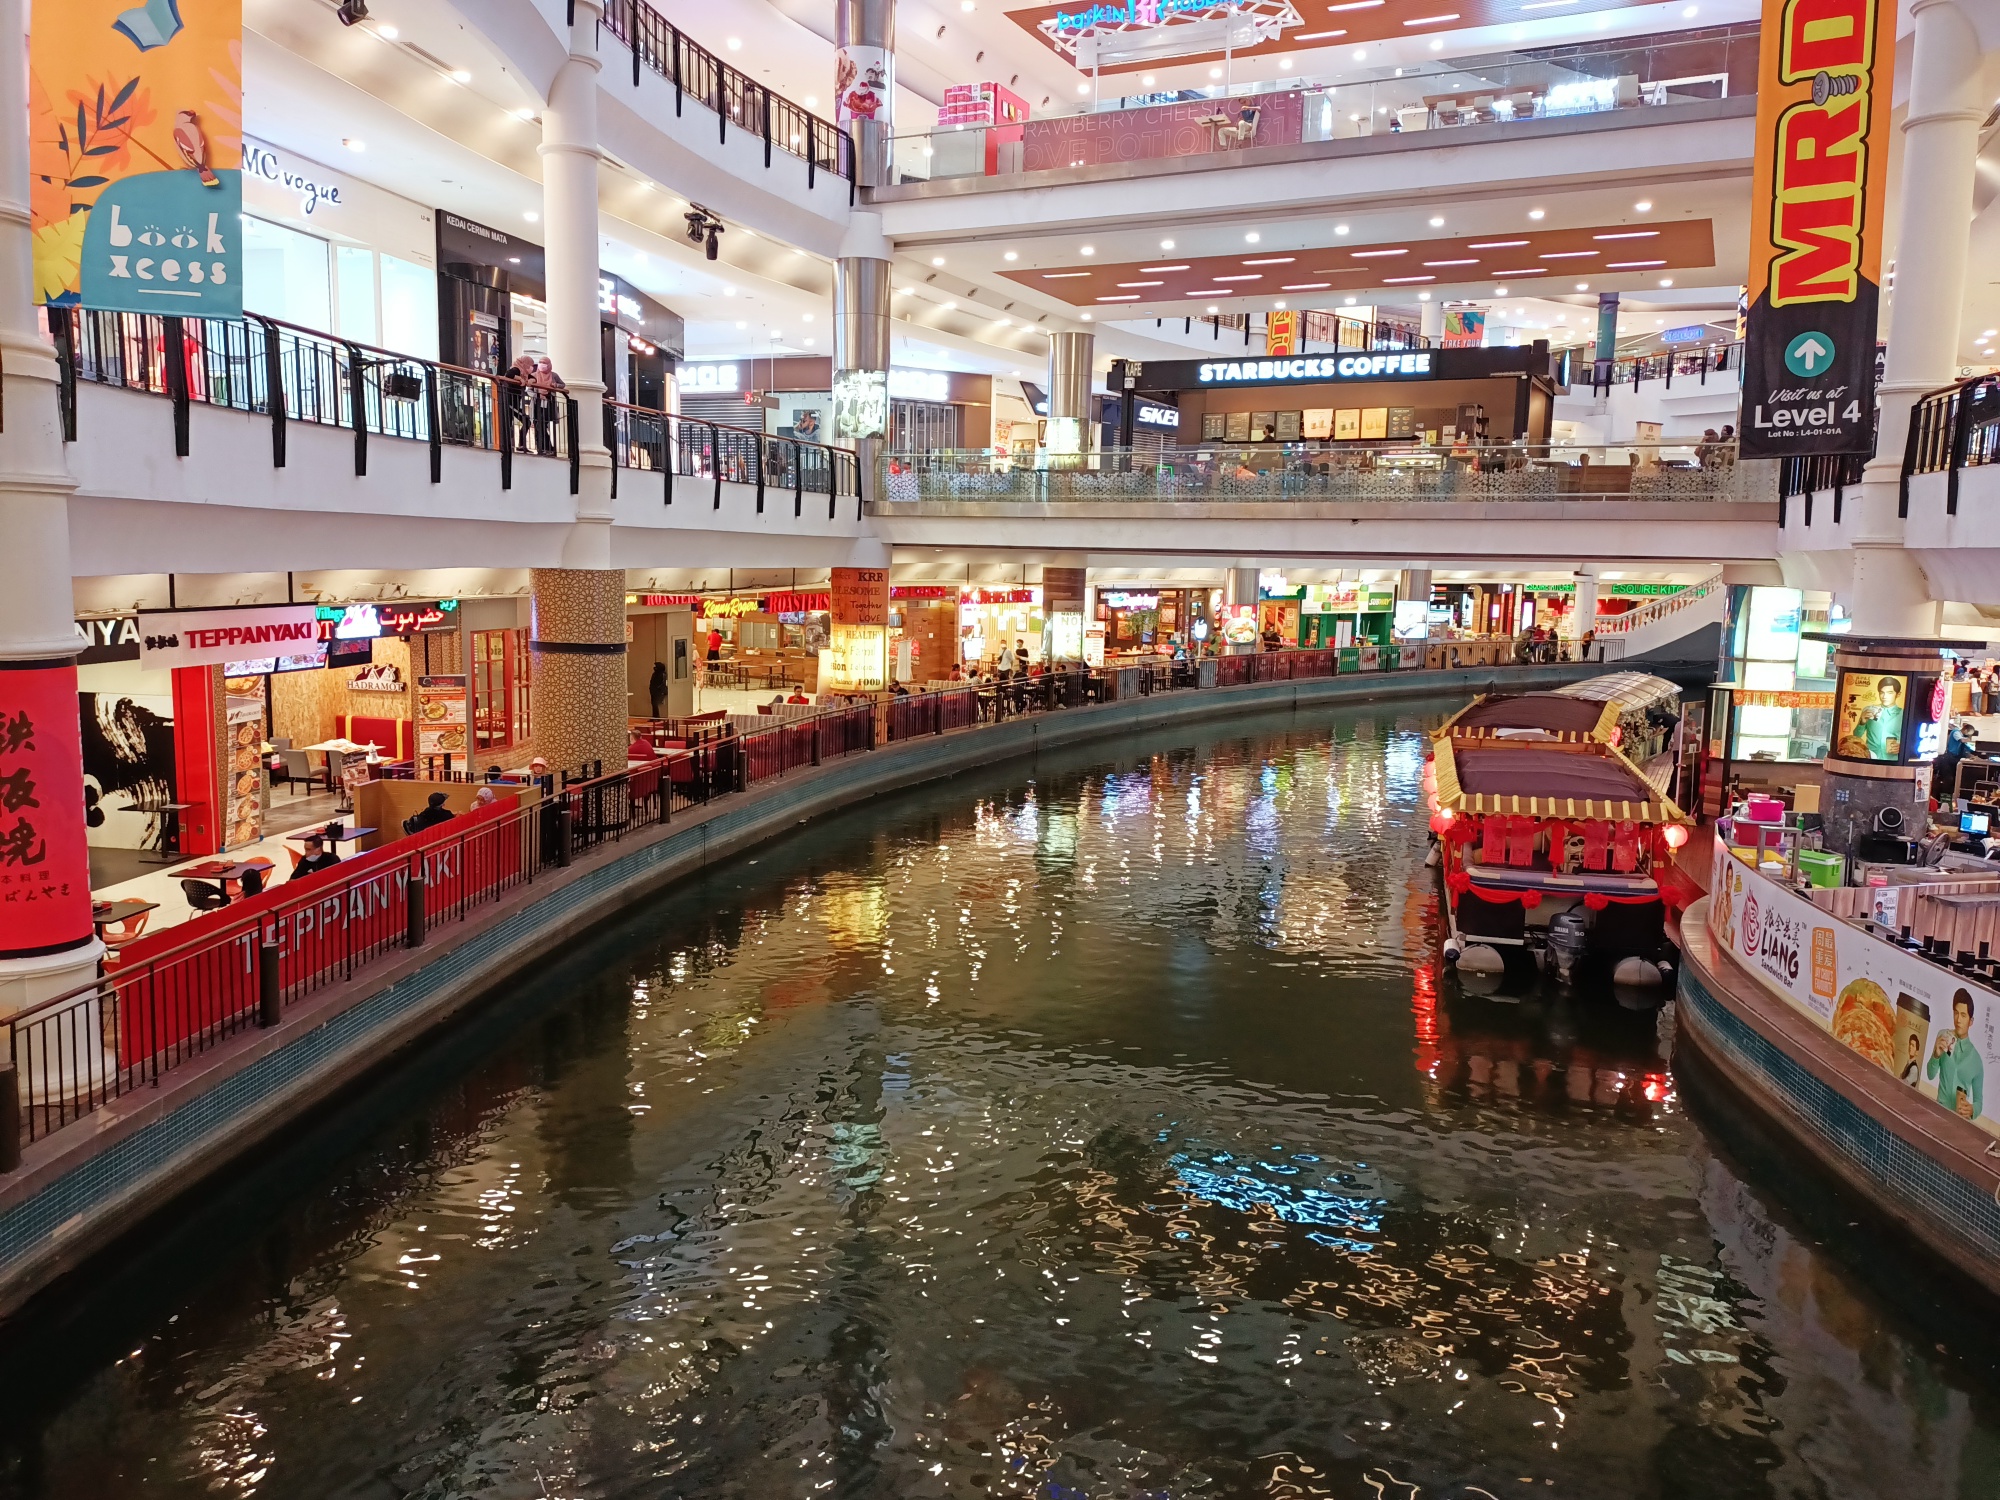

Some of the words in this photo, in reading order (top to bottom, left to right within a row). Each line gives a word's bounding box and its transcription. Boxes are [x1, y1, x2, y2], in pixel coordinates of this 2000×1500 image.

[280, 171, 342, 214] vogue
[446, 215, 466, 230] KEDAI
[466, 222, 490, 238] CERMIN
[491, 231, 508, 245] MATA
[108, 254, 227, 285] xcess
[1124, 363, 1143, 376] KAFE
[1199, 358, 1335, 382] STARBUCKS
[1338, 353, 1431, 377] COFFEE
[1768, 389, 1808, 404] Visit
[1807, 390, 1821, 400] us
[1825, 385, 1848, 399] at
[1754, 401, 1834, 428] Level
[1842, 400, 1861, 423] 4
[1768, 430, 1781, 438] Lot
[1801, 428, 1842, 436] L4-01-01A
[858, 571, 884, 582] KRR
[1612, 584, 1658, 594] ESQUIRE
[703, 599, 730, 618] Kenny
[729, 598, 759, 615] Rogers
[769, 593, 830, 613] ROASTERS
[1369, 598, 1391, 606] SUBWAY
[379, 608, 444, 632] حضرموت
[184, 622, 312, 649] TEPPANYAKI
[347, 680, 404, 692] HADRAMOT
[236, 844, 462, 973] TEPPANYAKI
[1761, 928, 1799, 979] LIANG
[1761, 958, 1784, 982] Sandwich
[1783, 976, 1793, 989] Bar
